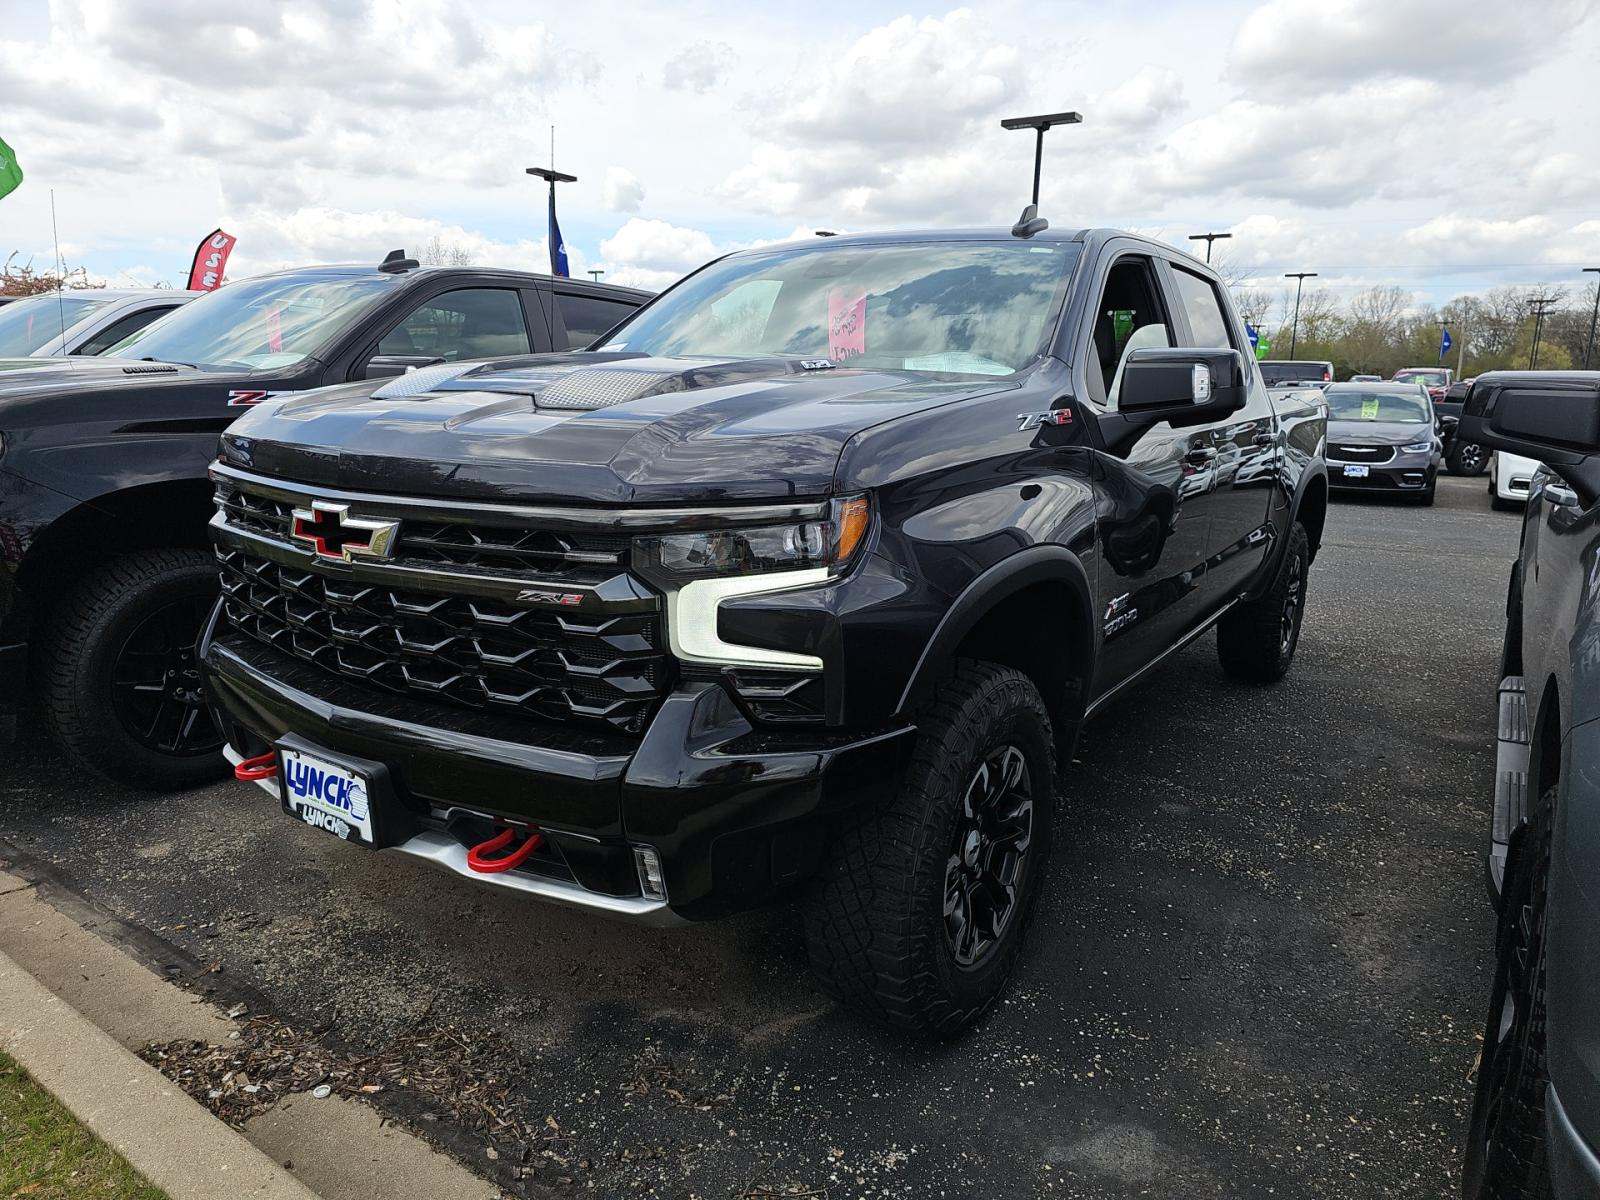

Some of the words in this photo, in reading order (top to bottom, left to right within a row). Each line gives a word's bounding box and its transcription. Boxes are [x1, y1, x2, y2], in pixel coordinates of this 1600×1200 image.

[1016, 408, 1073, 432] ZR2
[515, 589, 585, 606] ZR2
[286, 758, 353, 811] LYNCH
[302, 803, 342, 835] LYNCH
